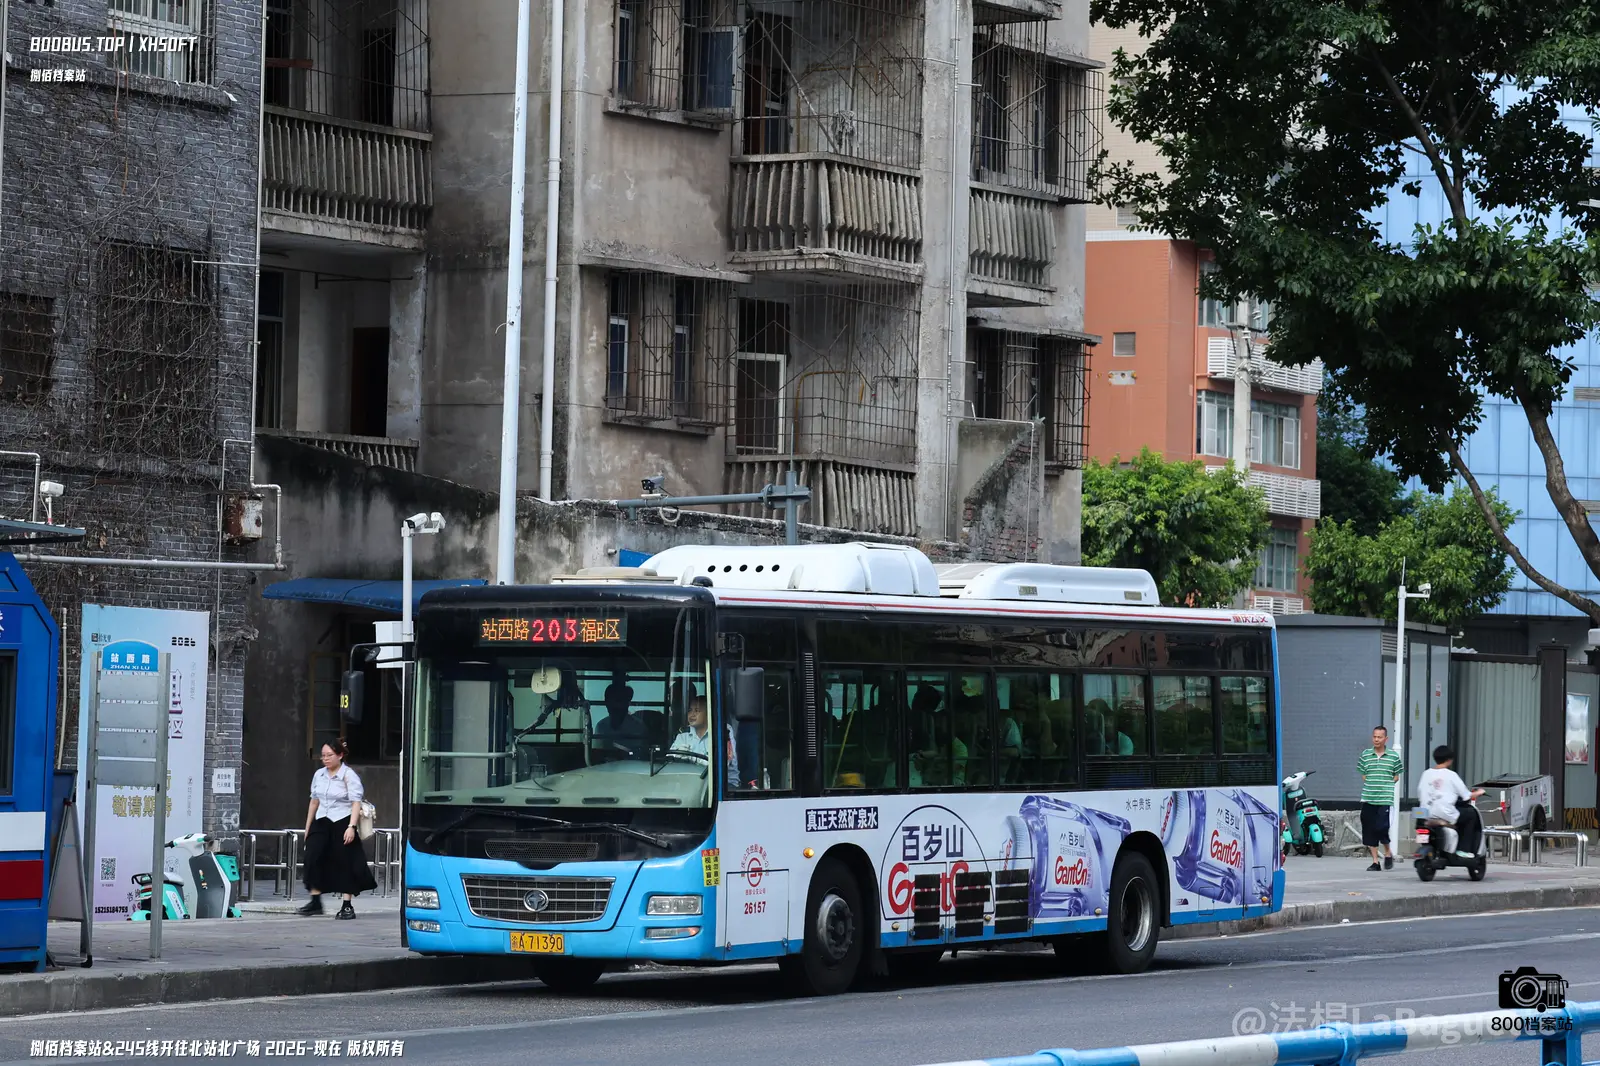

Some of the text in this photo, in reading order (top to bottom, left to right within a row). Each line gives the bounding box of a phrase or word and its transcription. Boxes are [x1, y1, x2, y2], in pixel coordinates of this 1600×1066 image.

[482, 618, 530, 641] 站西路
[532, 619, 577, 642] 203
[171, 637, 196, 647] 2026
[110, 653, 150, 664] 站西路
[340, 694, 349, 708] 03
[806, 809, 878, 832] 真正天然矿泉水
[902, 824, 964, 861] 百岁山
[744, 901, 766, 914] 26157
